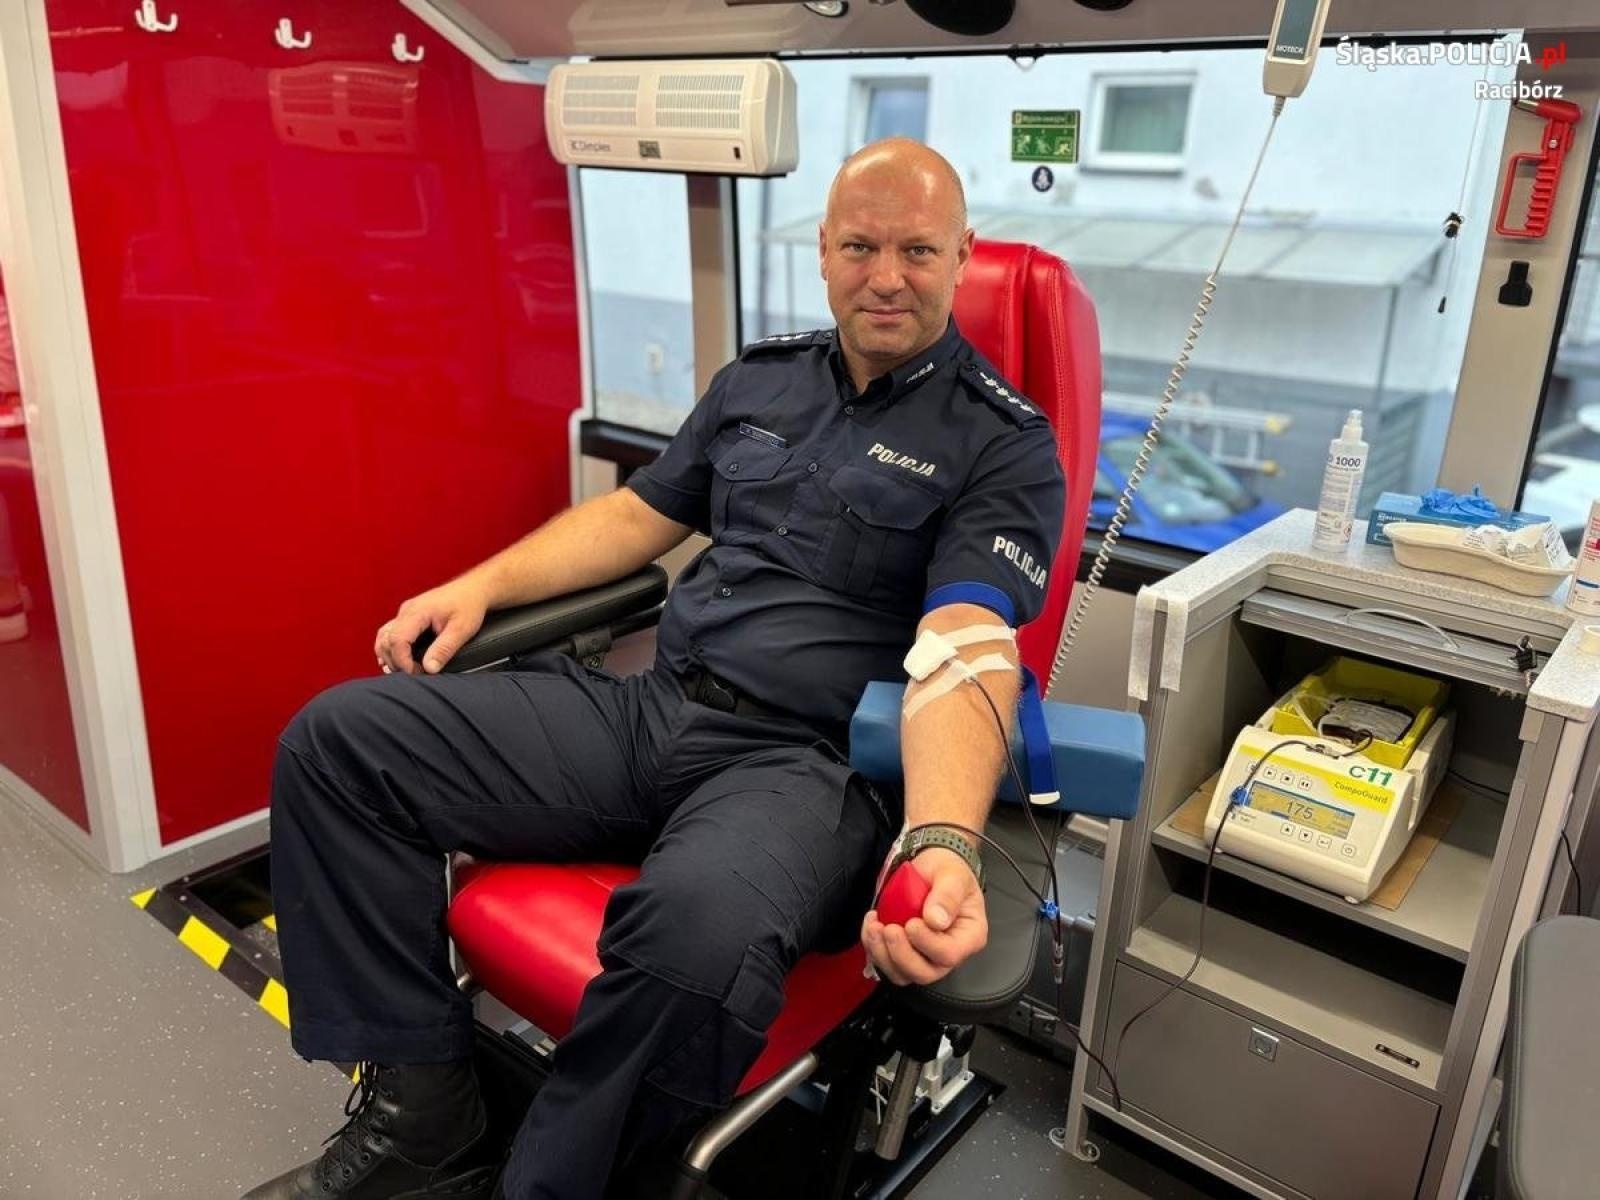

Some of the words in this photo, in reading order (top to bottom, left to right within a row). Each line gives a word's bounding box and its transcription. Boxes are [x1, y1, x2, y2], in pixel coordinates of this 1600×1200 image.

[867, 443, 936, 477] POLICJA
[1335, 456, 1361, 468] 1000
[993, 535, 1048, 589] POLICJA
[1334, 781, 1388, 804] CompoGuard
[1286, 801, 1313, 820] 175
